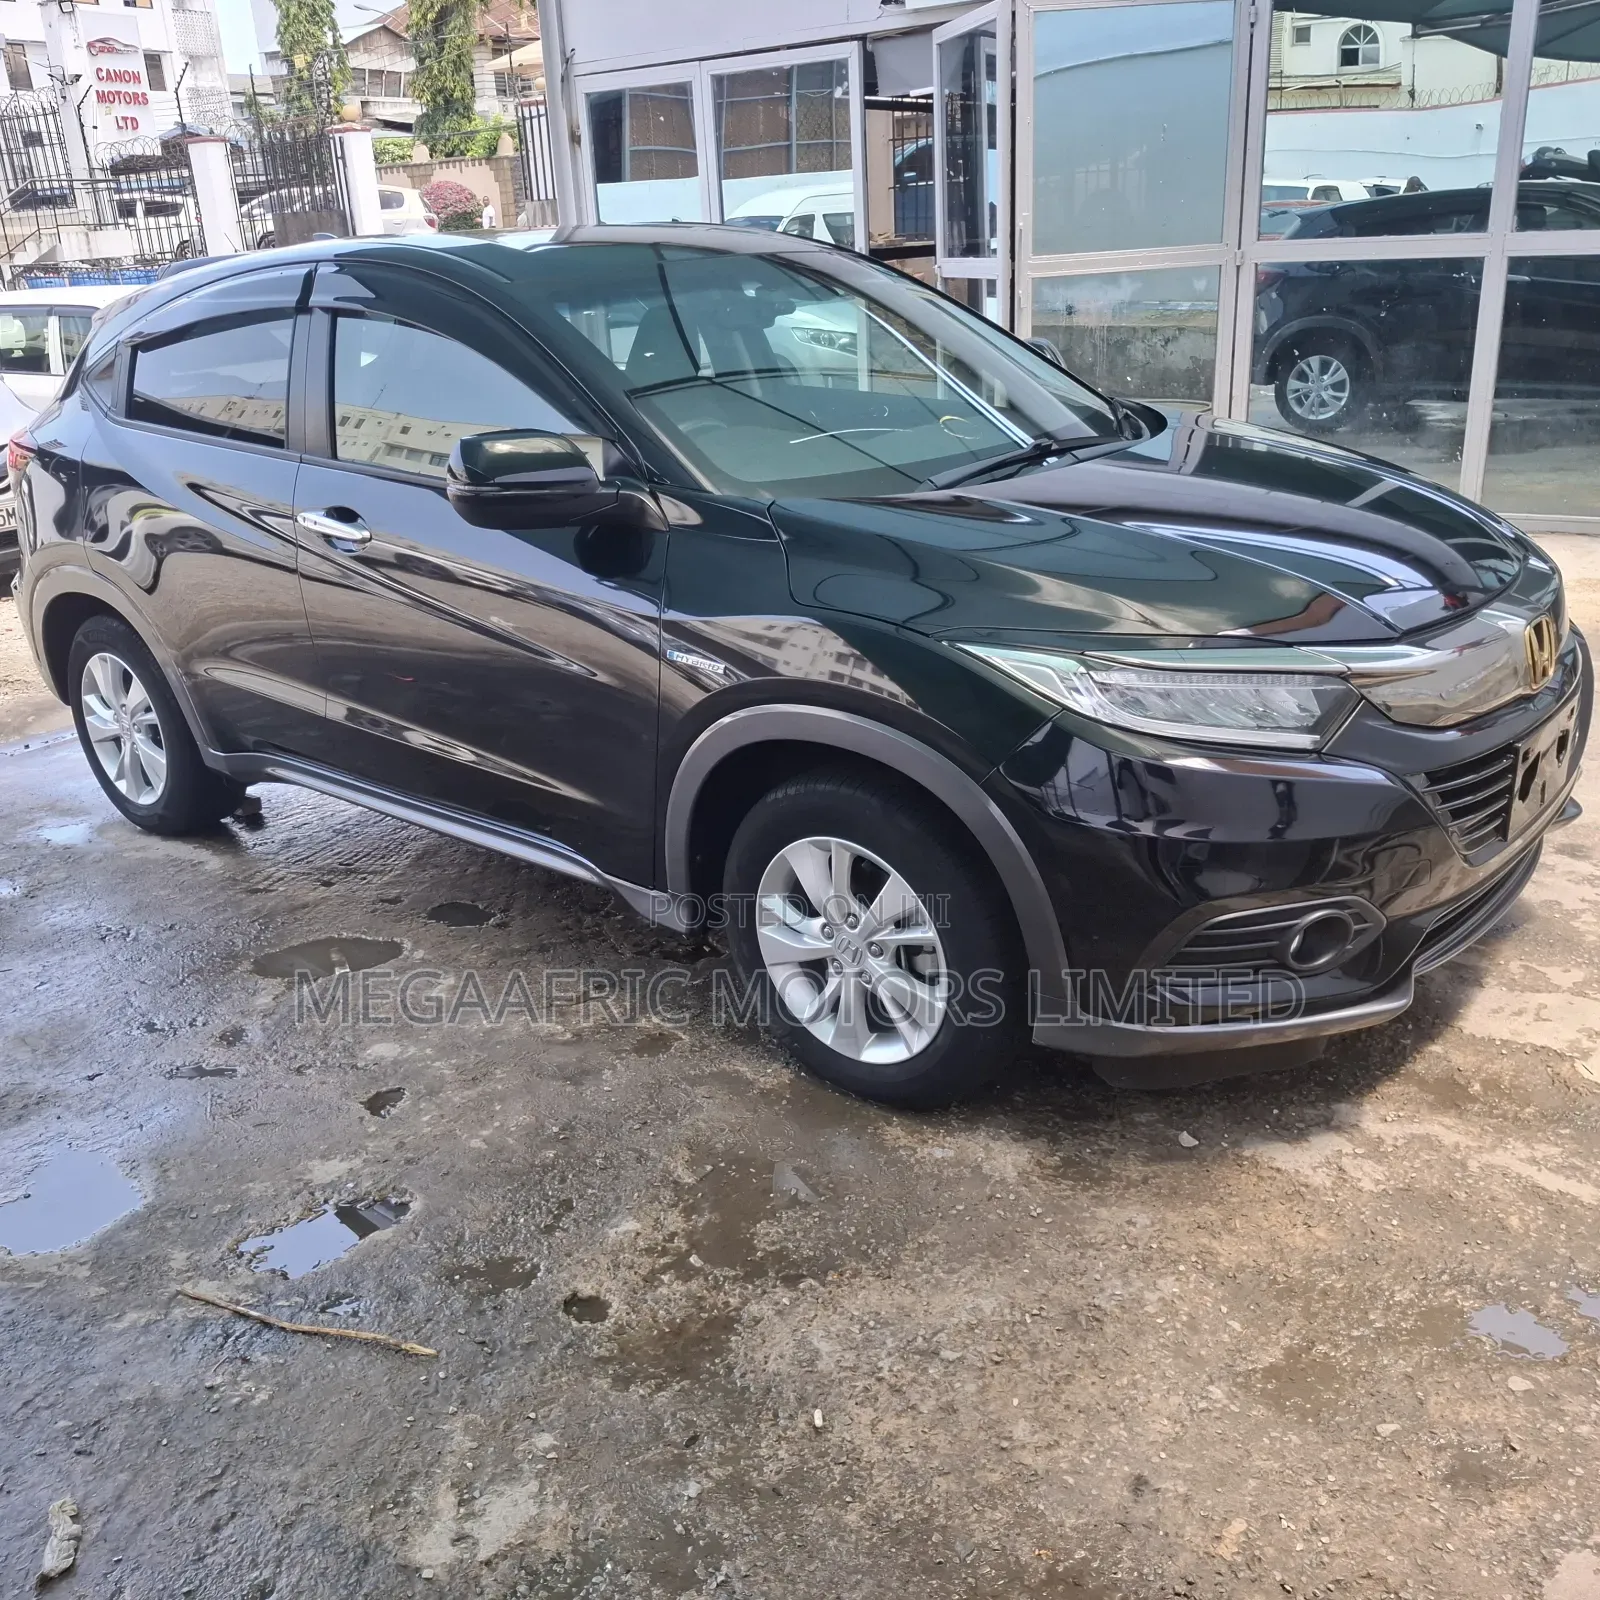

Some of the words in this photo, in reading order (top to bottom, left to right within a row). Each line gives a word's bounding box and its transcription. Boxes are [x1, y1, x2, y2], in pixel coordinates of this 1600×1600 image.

[95, 67, 141, 85] CANON
[95, 90, 149, 106] MOTORS
[115, 115, 139, 131] LTD
[675, 654, 720, 671] HYBRID
